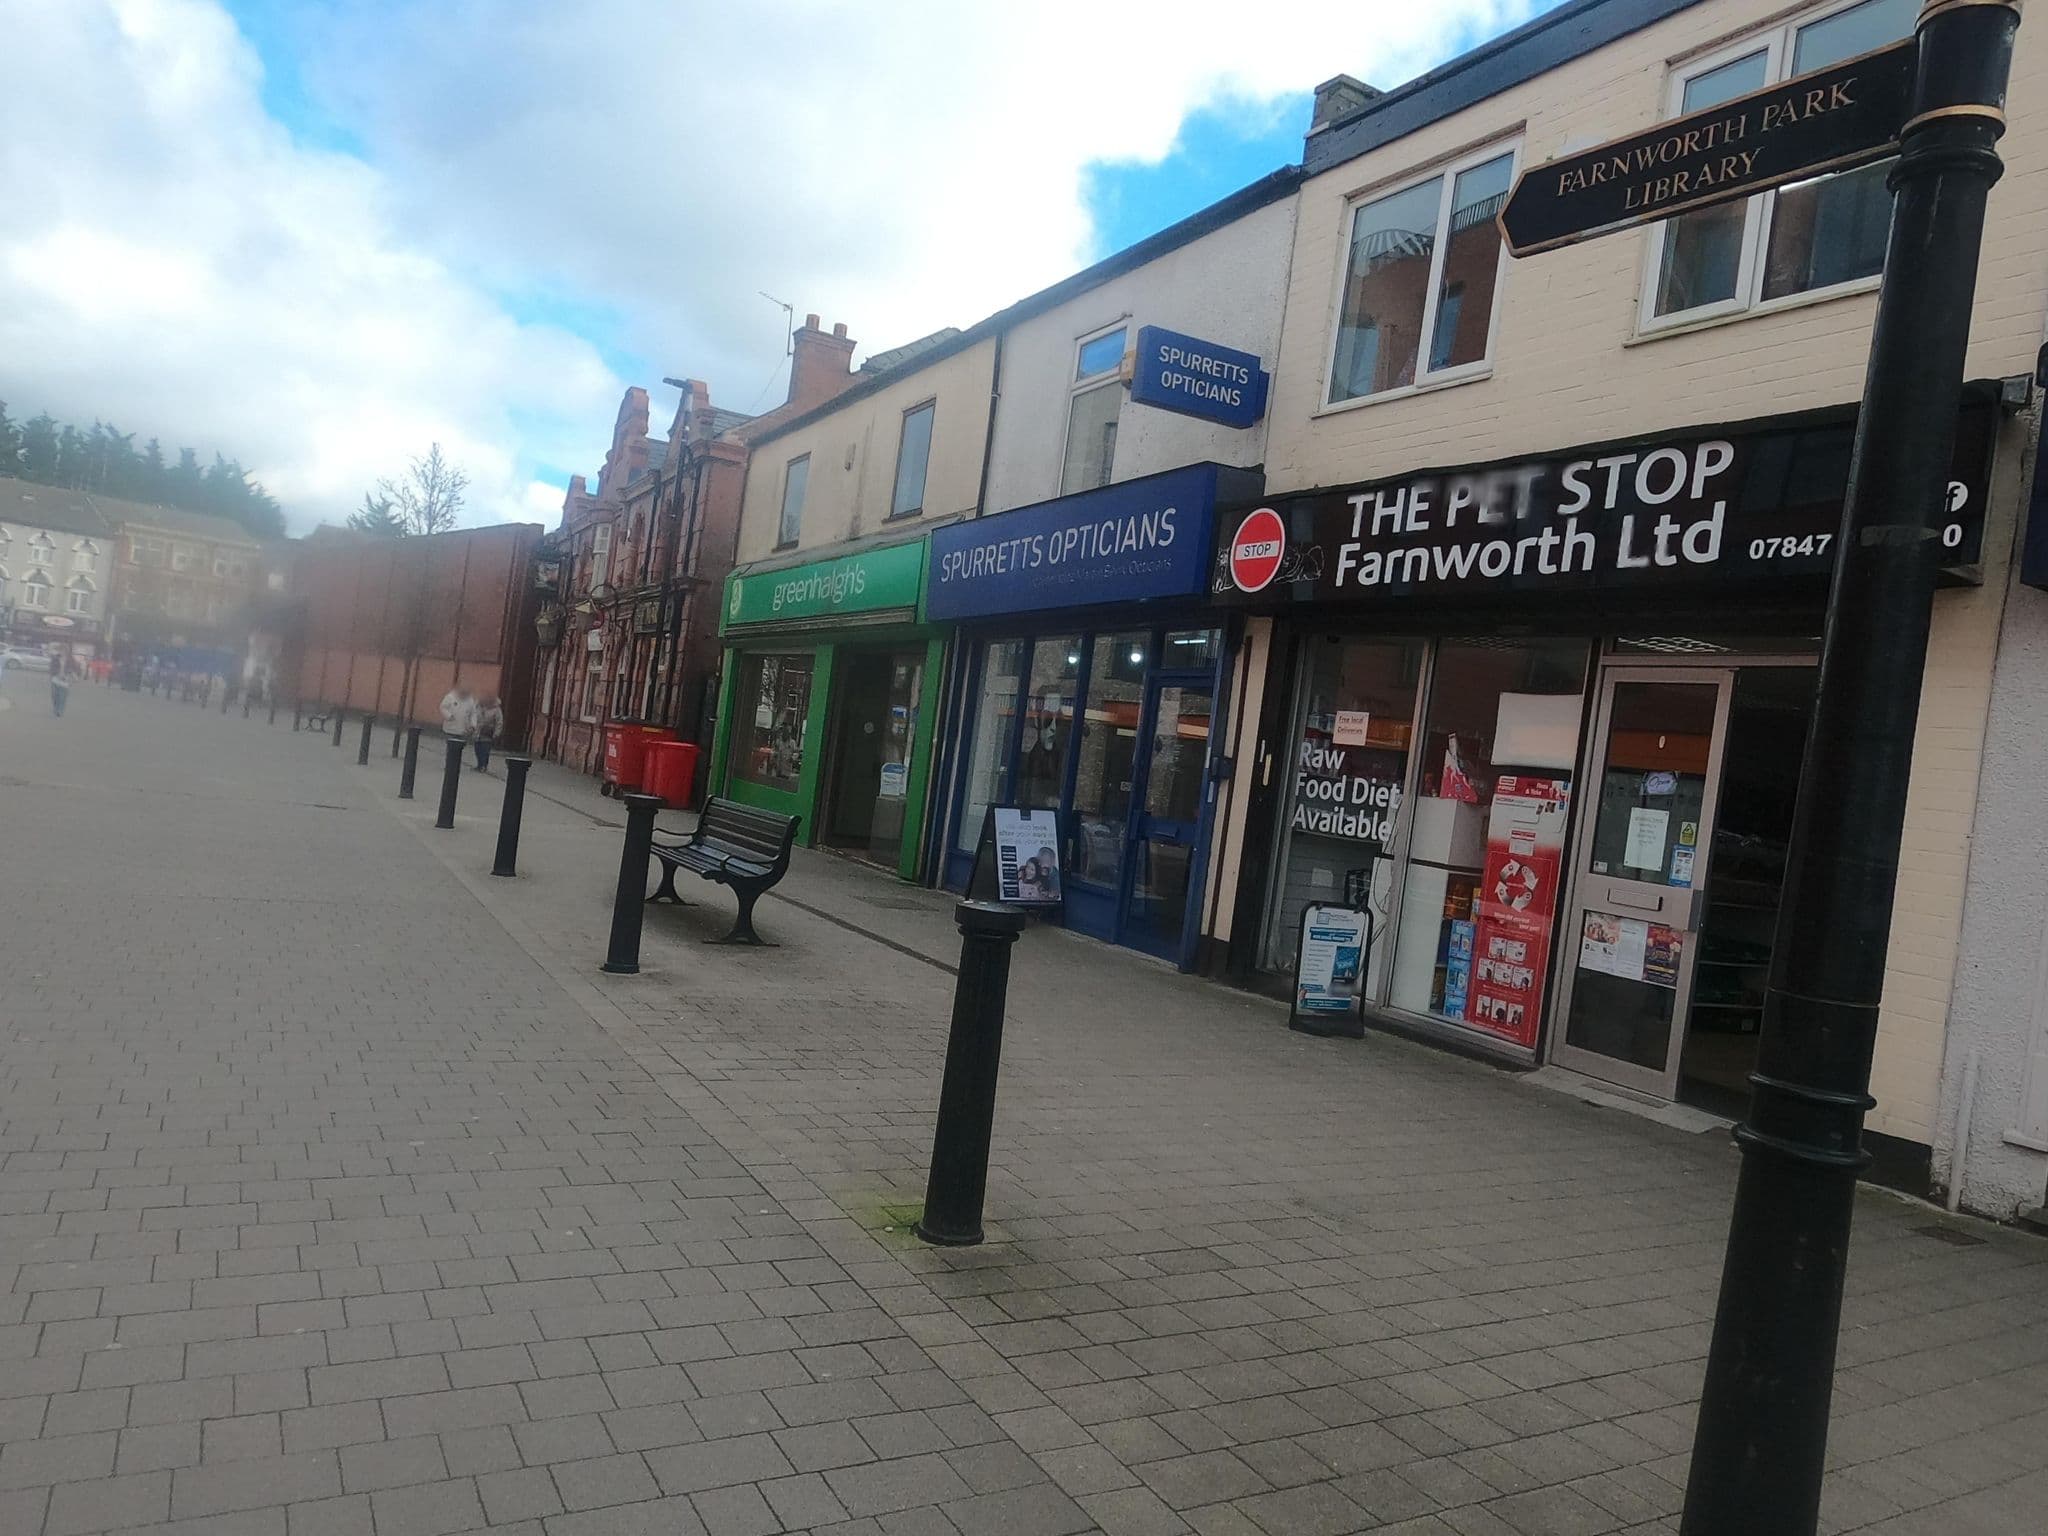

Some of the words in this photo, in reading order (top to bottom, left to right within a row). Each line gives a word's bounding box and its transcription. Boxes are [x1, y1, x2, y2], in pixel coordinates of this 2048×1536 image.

[1557, 115, 1746, 196] FARNWORTH
[1761, 78, 1858, 131] PARK
[1624, 147, 1765, 210] LIBRARY
[1158, 345, 1249, 384] SPURRETTS
[1161, 371, 1241, 406] OPTICIANS
[1347, 484, 1433, 538] THE
[1557, 440, 1735, 515] STOP
[940, 534, 1044, 583] SPURRETTS
[1048, 507, 1177, 564] OPTICIANS
[1243, 543, 1272, 558] STOP
[1335, 516, 1596, 587] Farnworth
[1616, 501, 1726, 569] Ltd
[1749, 534, 1833, 559] 07847
[772, 563, 866, 611] greenhalgh's
[1299, 741, 1346, 769] Raw
[1295, 772, 1347, 801] Food
[1351, 777, 1401, 809] Diet
[1291, 803, 1393, 842] Available
